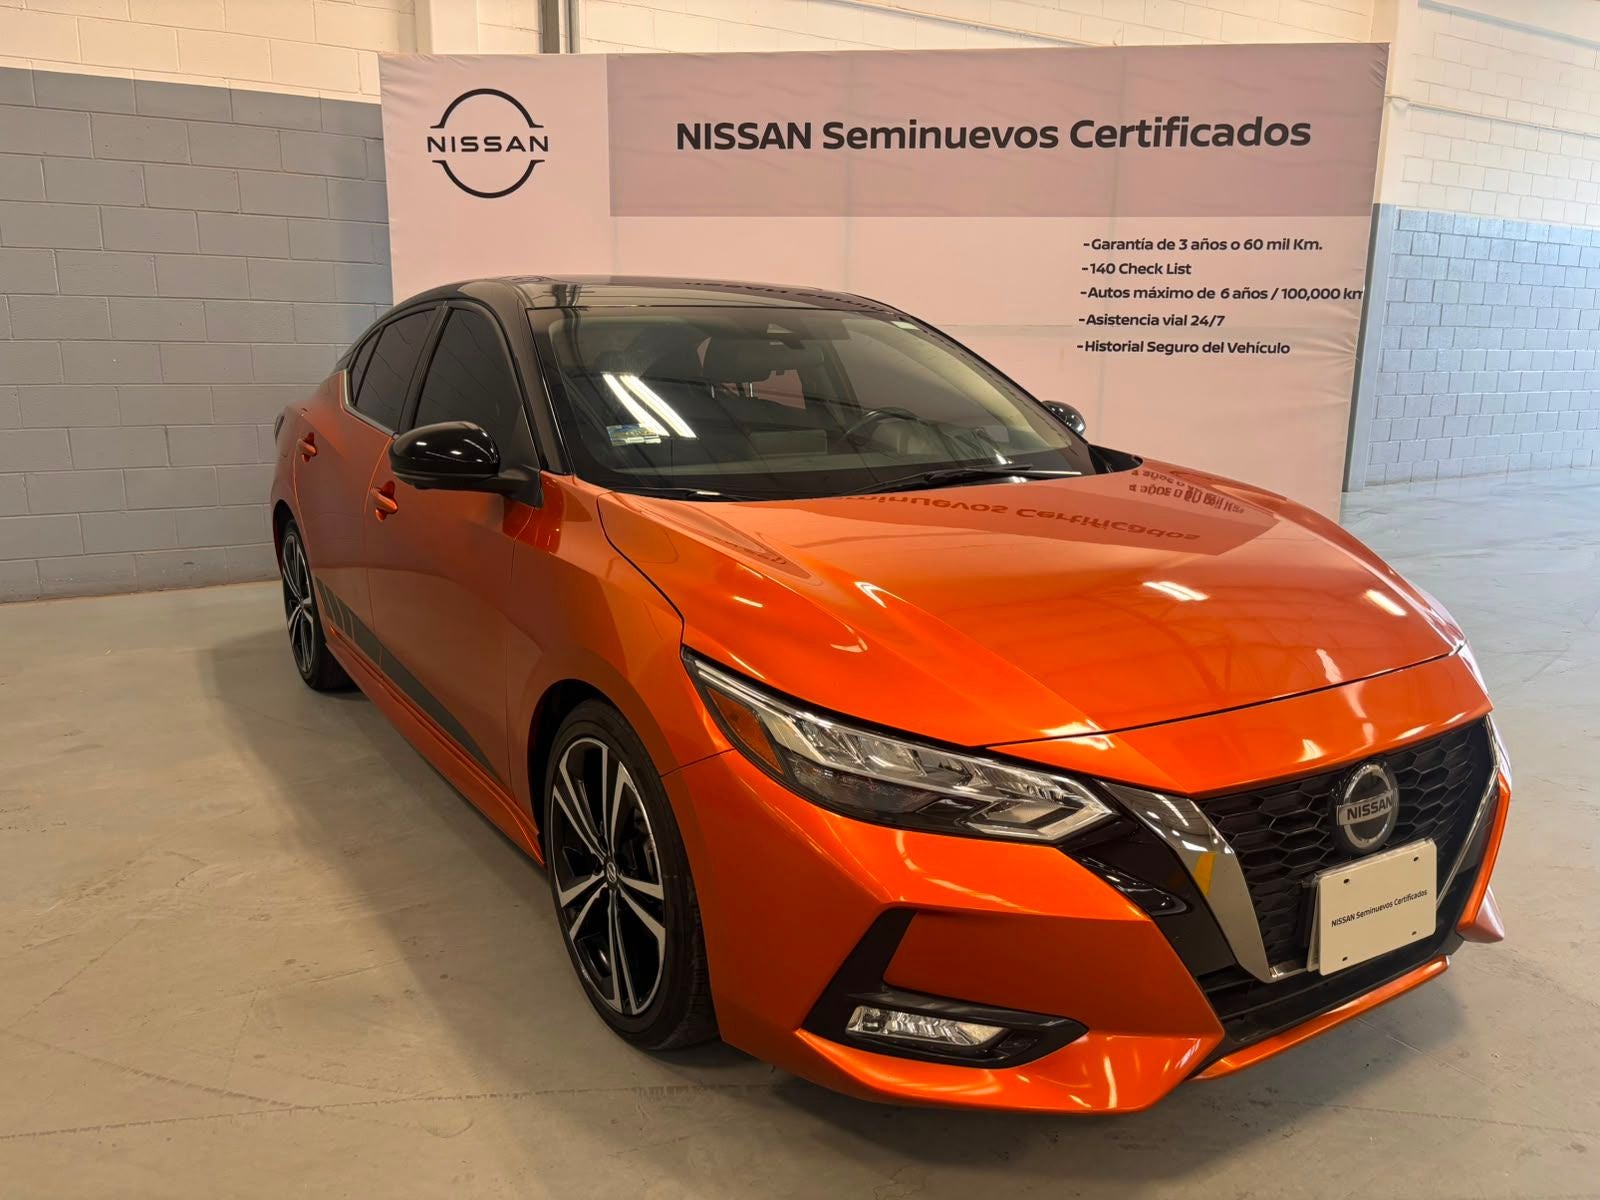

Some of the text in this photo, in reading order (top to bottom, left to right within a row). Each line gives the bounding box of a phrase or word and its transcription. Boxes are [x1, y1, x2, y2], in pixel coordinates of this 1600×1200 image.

[676, 115, 1312, 151] NISSAN Seminuevos Certificados
[426, 135, 549, 153] NISSAN
[1156, 238, 1176, 251] de
[1178, 238, 1188, 251] 3
[1190, 237, 1228, 251] años
[1230, 240, 1241, 251] o
[1243, 238, 1264, 251] 60
[1266, 237, 1291, 251] mil
[1292, 238, 1323, 251] Km.
[1118, 262, 1164, 275] Check
[1166, 262, 1192, 275] List
[1133, 285, 1195, 300] máximo
[1196, 287, 1216, 300] de
[1220, 287, 1231, 300] 6
[1232, 286, 1269, 300] años
[1281, 287, 1341, 302] 100,000
[1162, 313, 1188, 327] vial
[1190, 314, 1226, 328] 24/7
[1146, 341, 1200, 356] Seguro
[1201, 341, 1225, 354] del
[1226, 341, 1291, 355] Vehículo
[1346, 795, 1393, 821] NISSAN
[1331, 889, 1428, 928] NISSAN Seminuevos Certificados
